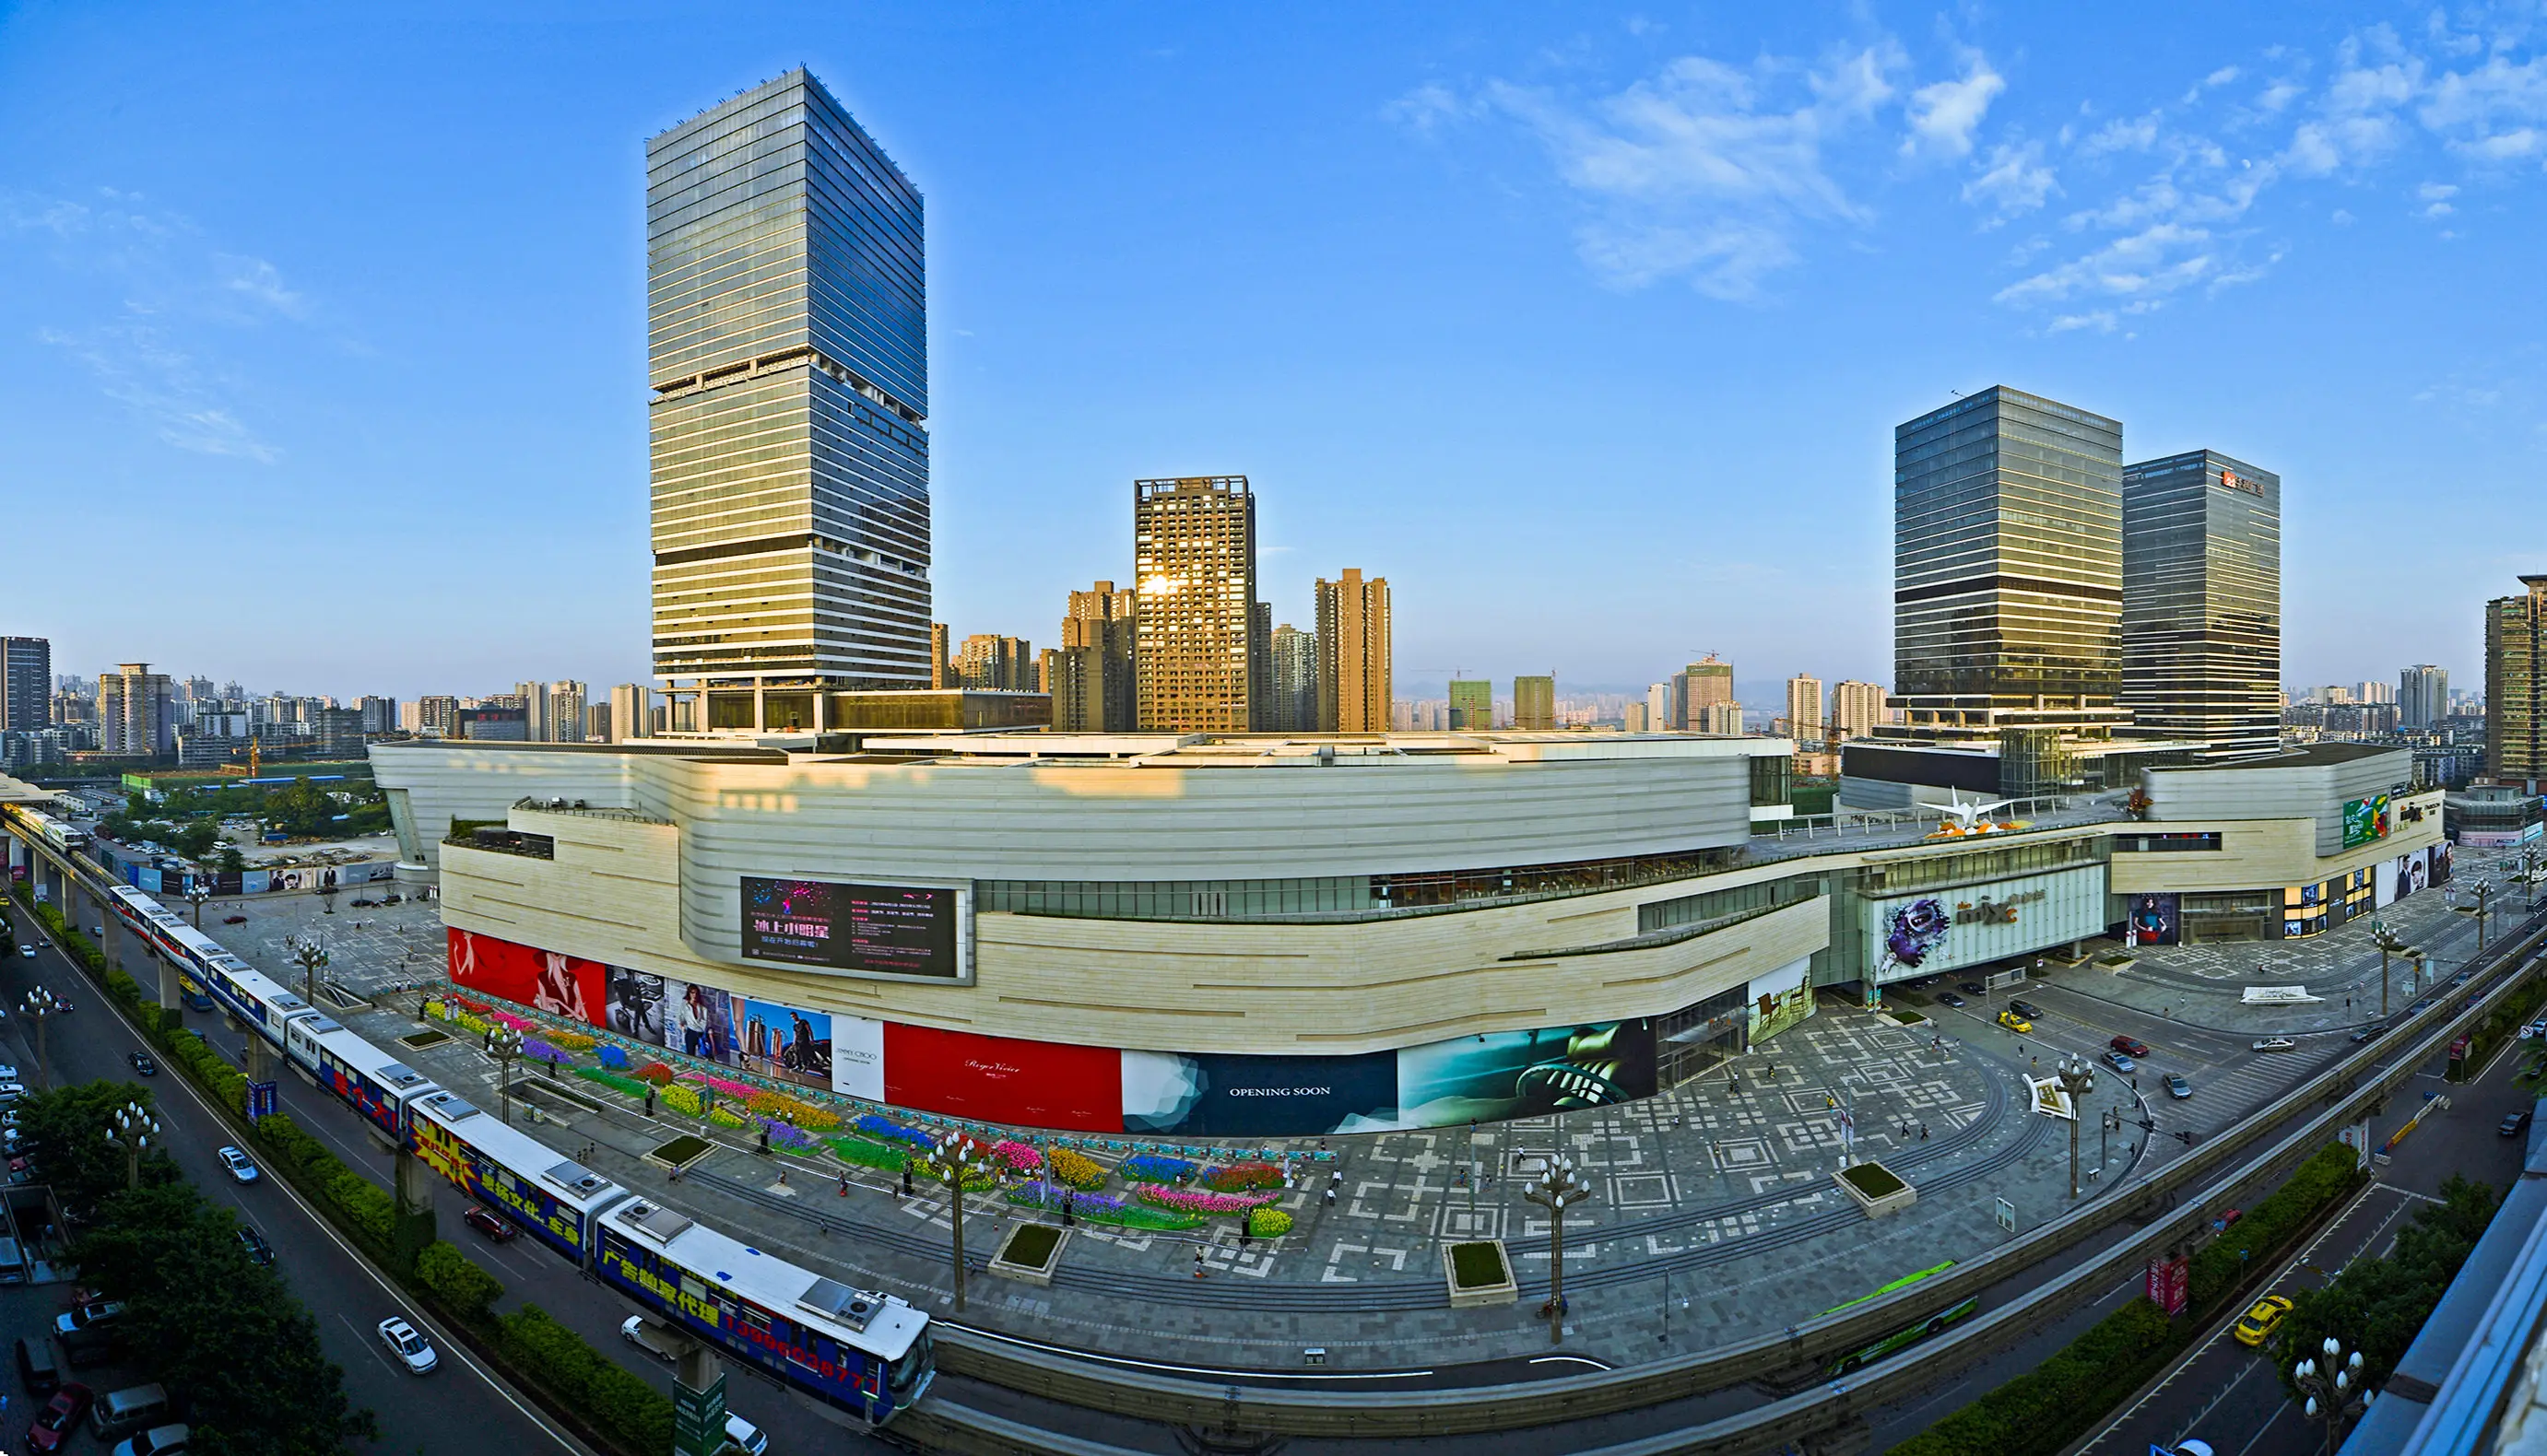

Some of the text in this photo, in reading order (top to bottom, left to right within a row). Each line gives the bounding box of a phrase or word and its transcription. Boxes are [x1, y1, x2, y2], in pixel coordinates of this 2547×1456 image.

[753, 919, 830, 939] 冰上小明星
[1230, 1086, 1330, 1097] OPENING SOON
